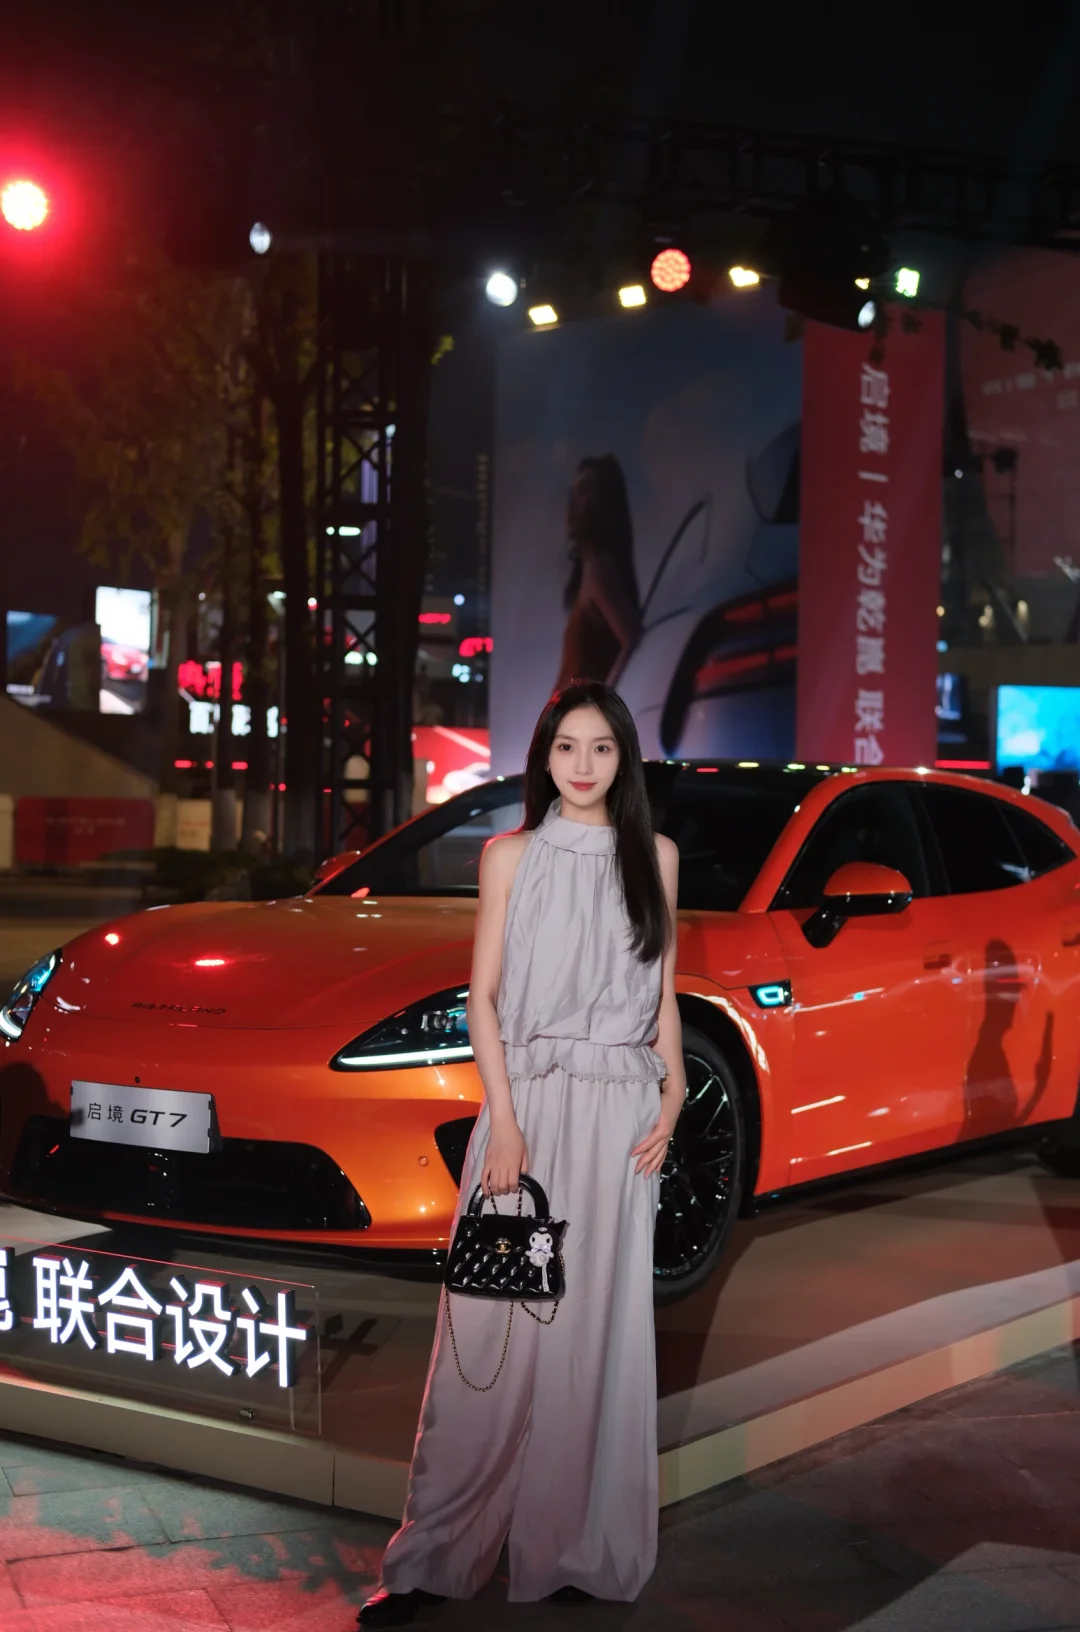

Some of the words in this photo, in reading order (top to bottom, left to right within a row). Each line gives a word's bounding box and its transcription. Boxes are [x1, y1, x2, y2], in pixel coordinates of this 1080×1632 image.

[861, 363, 890, 454] 启境
[87, 1102, 123, 1123] 启境
[130, 1108, 188, 1127] GT7
[33, 1256, 307, 1388] 联合设计
